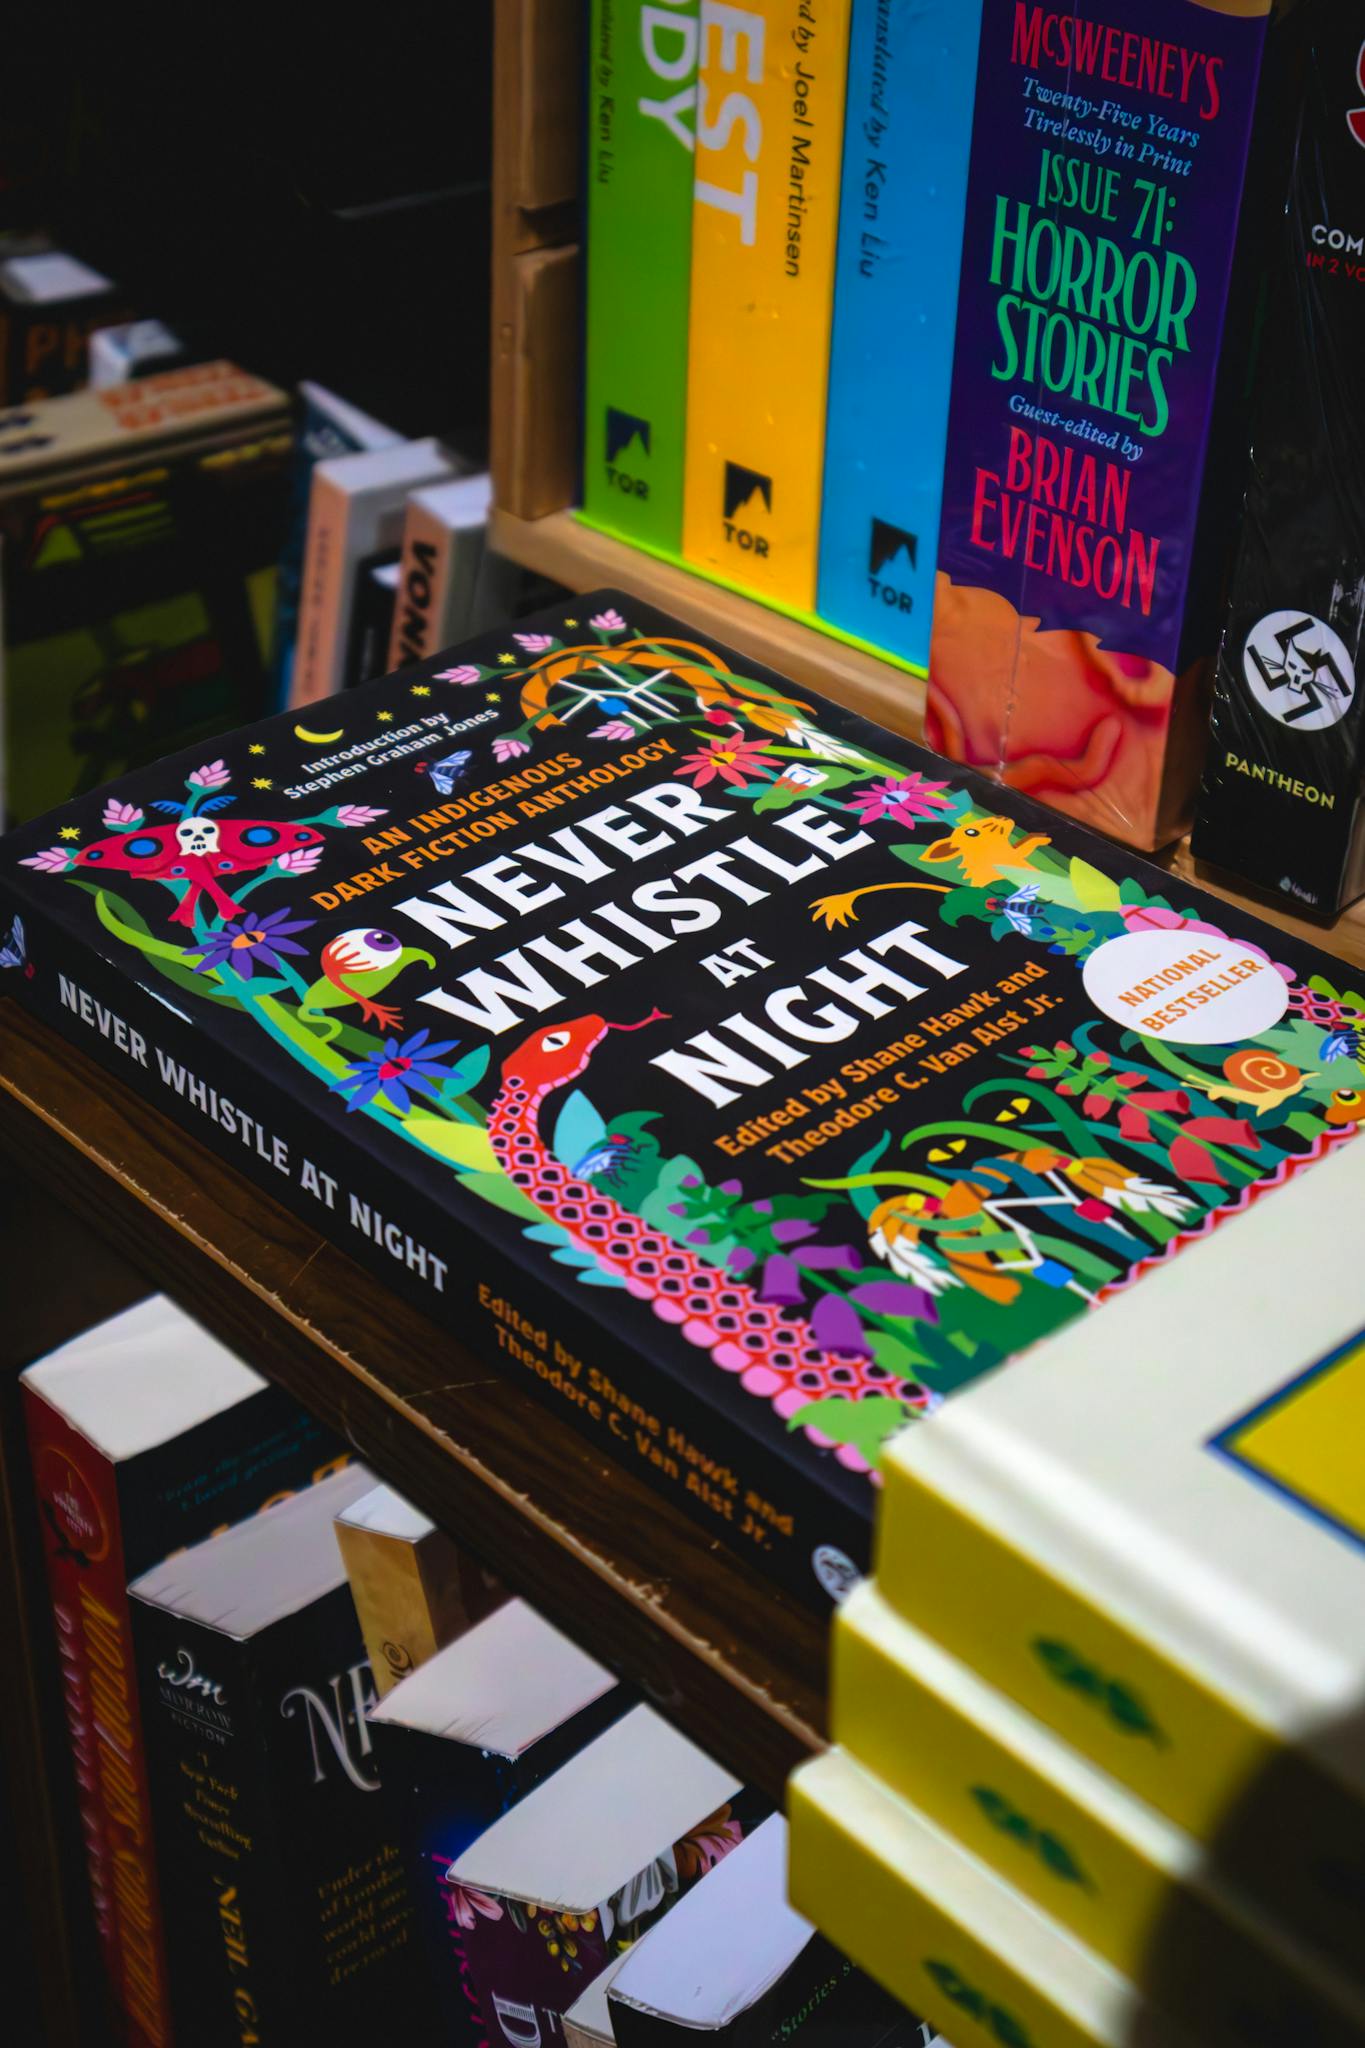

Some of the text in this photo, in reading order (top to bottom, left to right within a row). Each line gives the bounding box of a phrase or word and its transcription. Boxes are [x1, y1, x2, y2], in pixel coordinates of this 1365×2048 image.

[792, 26, 816, 53] by
[600, 94, 615, 143] Ken
[793, 61, 816, 128] Joel
[863, 116, 888, 149] by
[1022, 77, 1200, 149] Twenty-Five Years
[1024, 107, 1193, 177] Tirelessly in Print
[785, 135, 813, 278] Martinsen
[863, 157, 887, 221] Ken
[1038, 149, 1176, 247] ISSUE 71:
[859, 231, 883, 279] Liu
[989, 194, 1197, 352] HORROR
[991, 294, 1173, 437] STORIES
[1009, 394, 1144, 462] Guest-edited by
[605, 467, 649, 500] TOR
[1005, 425, 1132, 534] BRIAN
[723, 522, 770, 559] TOR
[970, 466, 1161, 617] EVENSON
[868, 577, 913, 614] TOR
[283, 708, 500, 800] Stephen Graham Jones
[301, 712, 450, 775] Introduction by
[1225, 751, 1336, 810] PANTHEON
[310, 738, 678, 911] DARK FICTION ANTHOLOGY
[360, 752, 583, 856] AN INDIGENOUS
[392, 782, 738, 950] NEVER
[415, 804, 876, 1037] WHISTLE
[698, 938, 775, 989] AT
[648, 920, 970, 1110] NIGHT
[1118, 948, 1222, 1007] NATIONAL
[1139, 959, 1265, 1032] BESTSELLER
[713, 960, 1050, 1157] Edited by Shane Hawk and
[765, 992, 1064, 1165] Theodore C. Van Alst Jr.
[57, 972, 448, 1293] NEVER WHISTLE AT NIGHT
[478, 1282, 795, 1537] Edited by Shane Hawk and
[495, 1323, 773, 1551] Theodore C. Van Alst Jr.
[78, 1581, 144, 1847] NOTORIOUS
